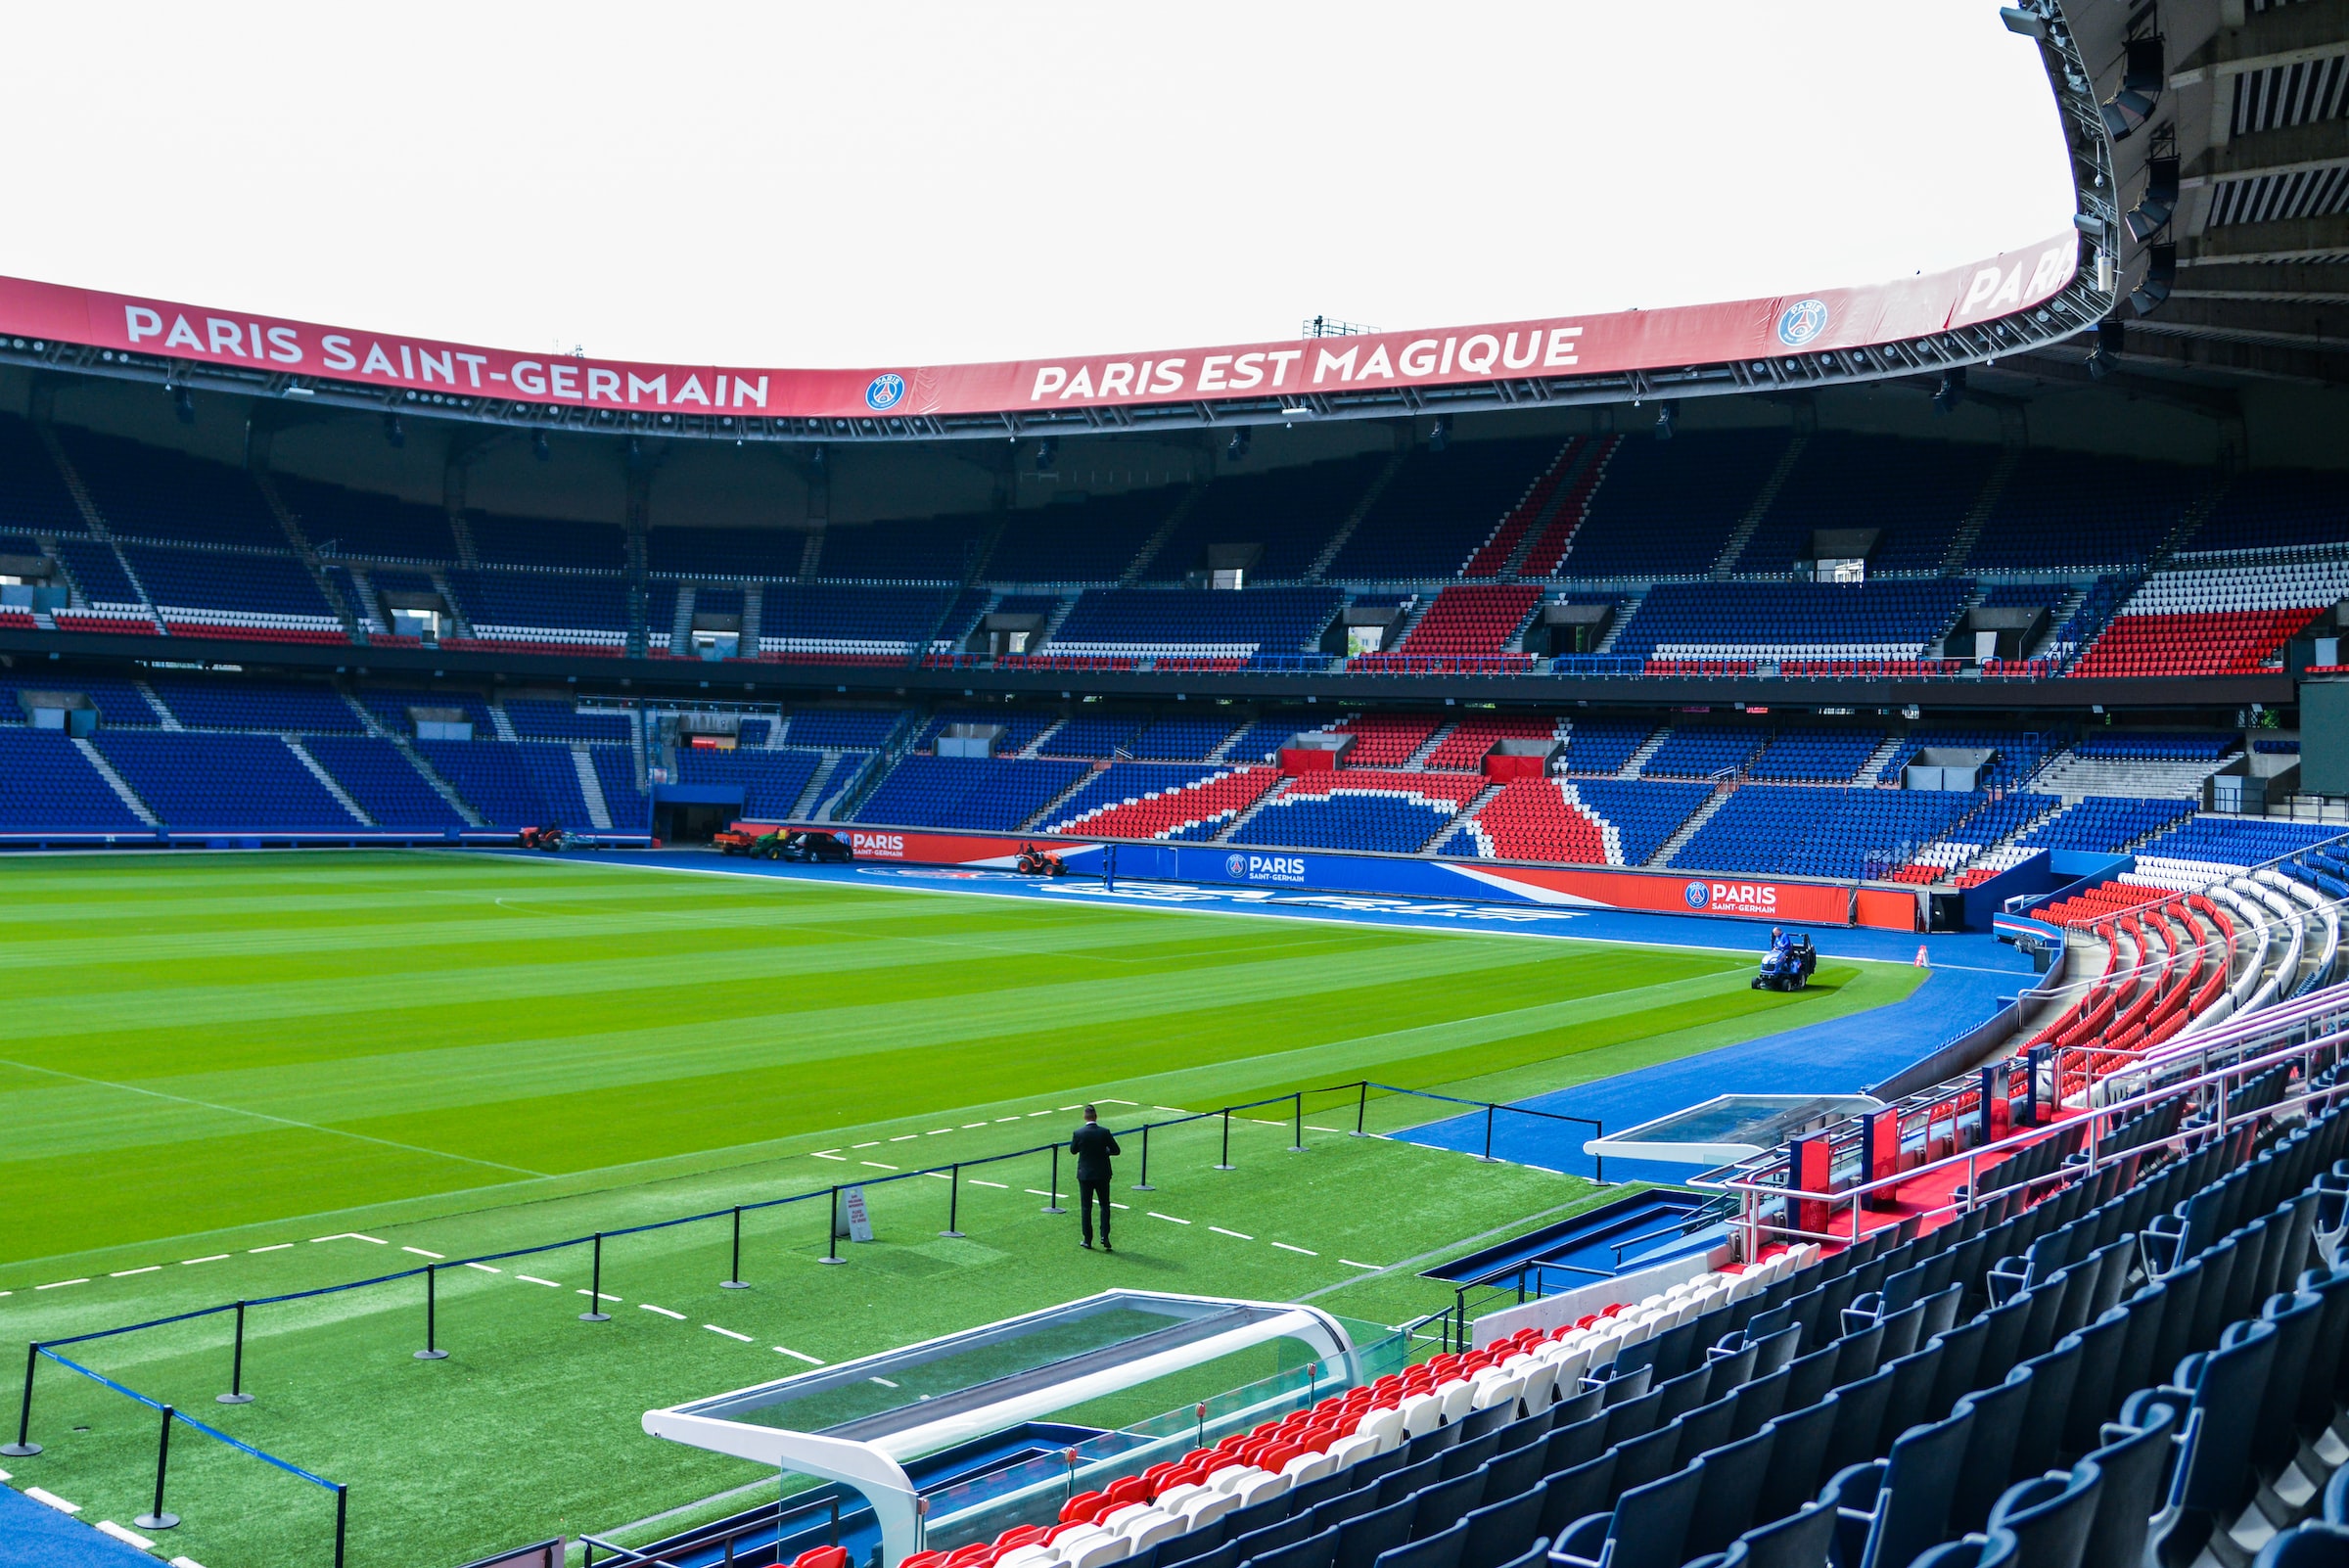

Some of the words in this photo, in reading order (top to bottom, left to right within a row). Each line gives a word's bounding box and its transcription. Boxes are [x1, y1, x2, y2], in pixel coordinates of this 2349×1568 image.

[1790, 301, 1822, 314] PARIS
[125, 305, 303, 363] PARIS
[321, 335, 768, 408] SAINT-GERMAIN
[1030, 357, 1186, 401] PARIS
[1196, 349, 1303, 392] EST
[1312, 326, 1584, 384] MAGIQUE
[853, 833, 904, 851] PARIS
[1249, 855, 1306, 875] PARIS
[1712, 883, 1776, 905] PARIS
